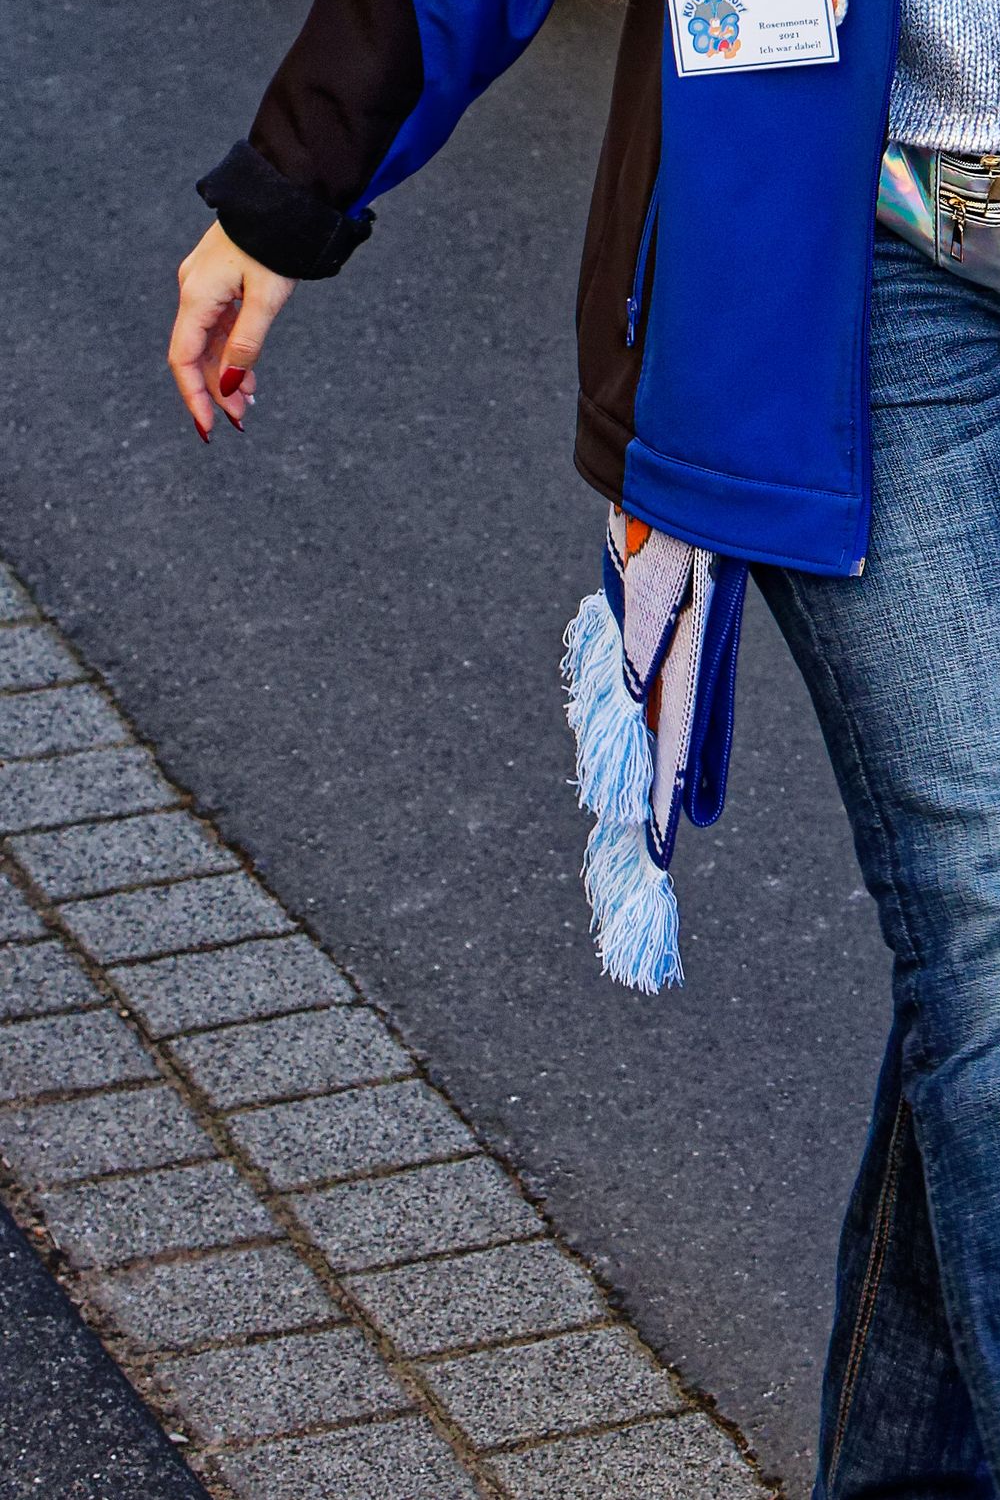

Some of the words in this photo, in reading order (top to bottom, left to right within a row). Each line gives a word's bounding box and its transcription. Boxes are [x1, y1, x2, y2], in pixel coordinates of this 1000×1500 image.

[759, 18, 819, 30] Rosenmontag
[779, 32, 799, 40] 2021
[760, 45, 774, 54] Ich
[795, 40, 821, 51] dabei!
